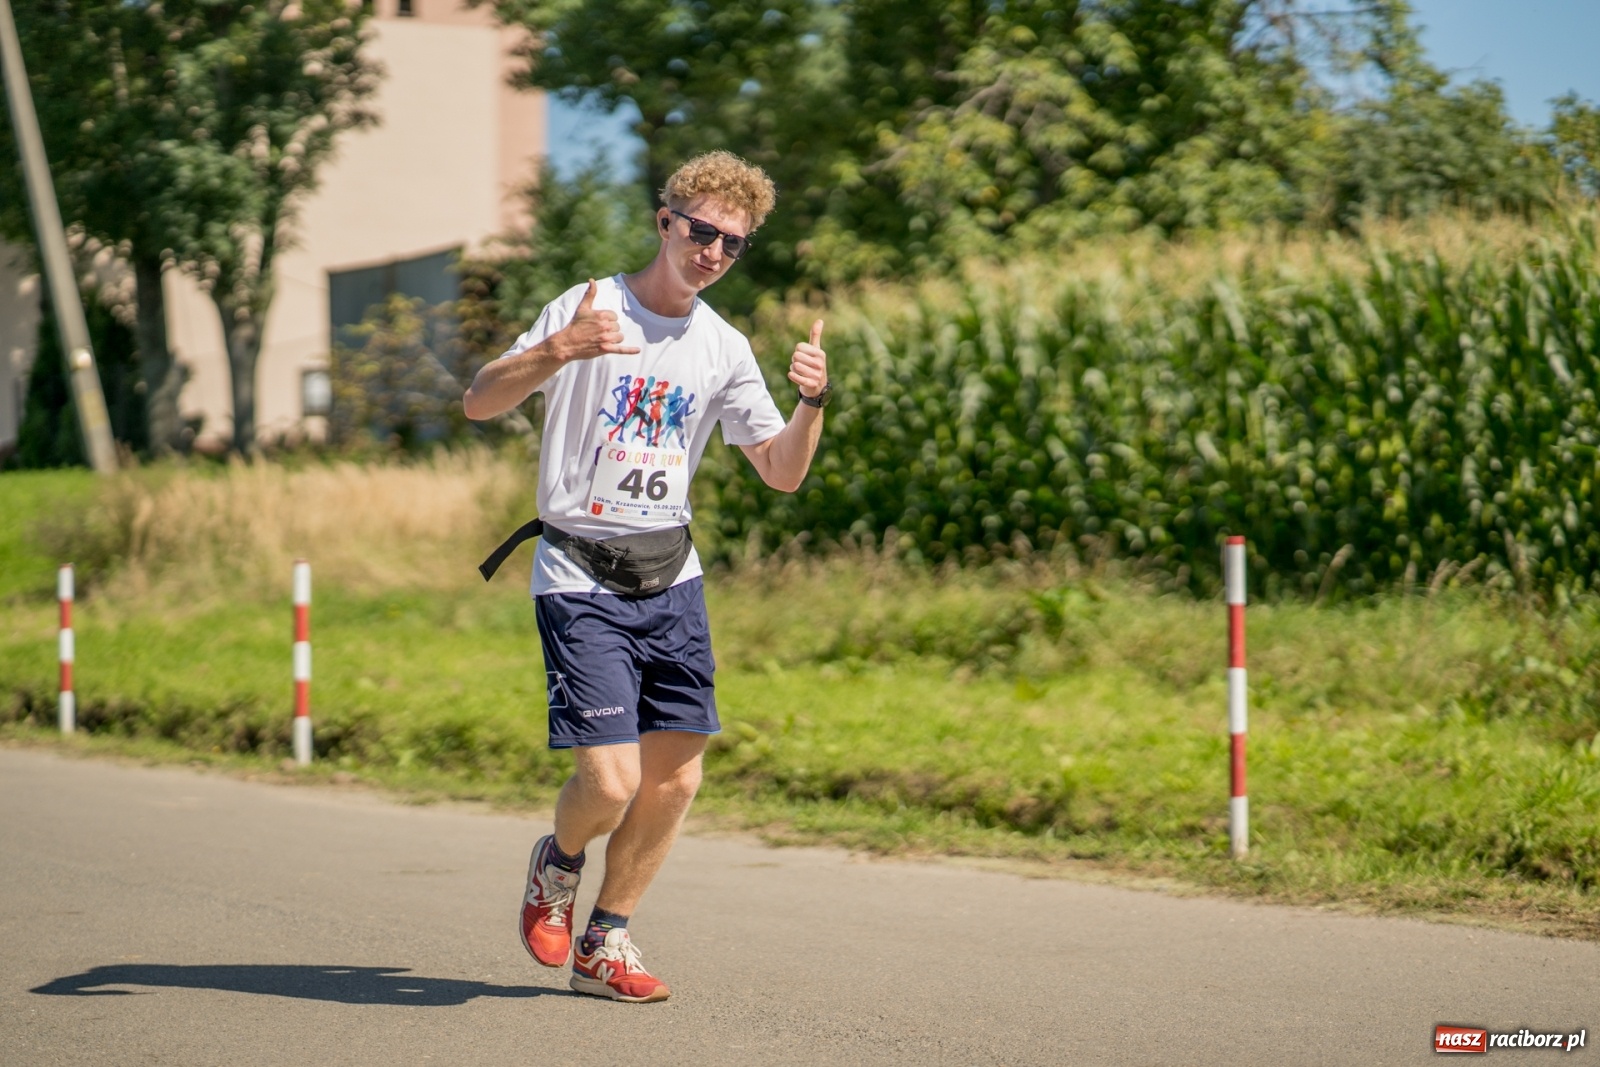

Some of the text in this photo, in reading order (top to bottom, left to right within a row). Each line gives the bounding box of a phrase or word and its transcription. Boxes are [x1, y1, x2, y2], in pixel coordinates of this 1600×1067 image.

[607, 448, 682, 467] COLOUR RUN
[617, 468, 668, 501] 46
[593, 496, 613, 505] 10km,
[582, 706, 625, 718] GIVOVA
[596, 961, 615, 984] N
